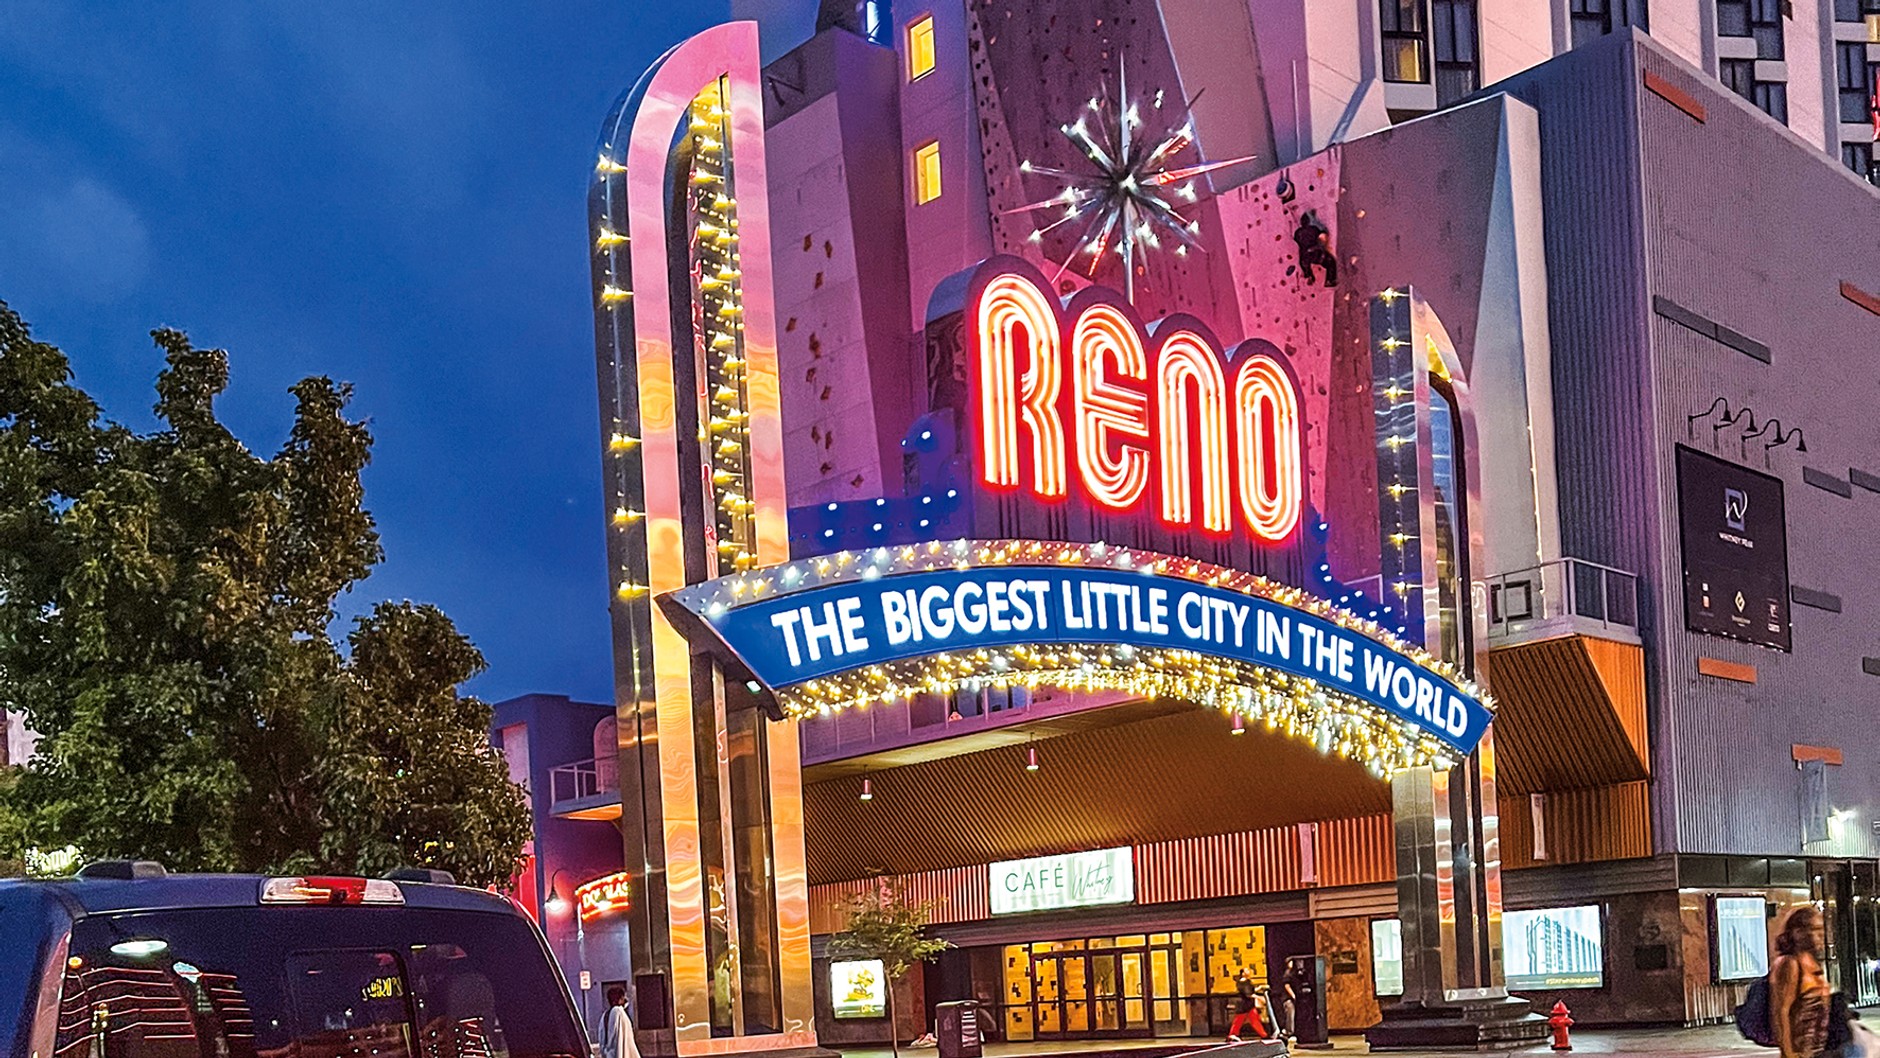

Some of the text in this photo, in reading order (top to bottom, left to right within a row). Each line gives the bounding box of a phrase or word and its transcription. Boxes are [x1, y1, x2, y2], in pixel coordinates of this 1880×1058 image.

[978, 273, 1302, 541] RENO
[771, 580, 1468, 738] THE BIGGEST LITTLE CITY IN THE WORLD
[1005, 863, 1064, 892] CAFÉ
